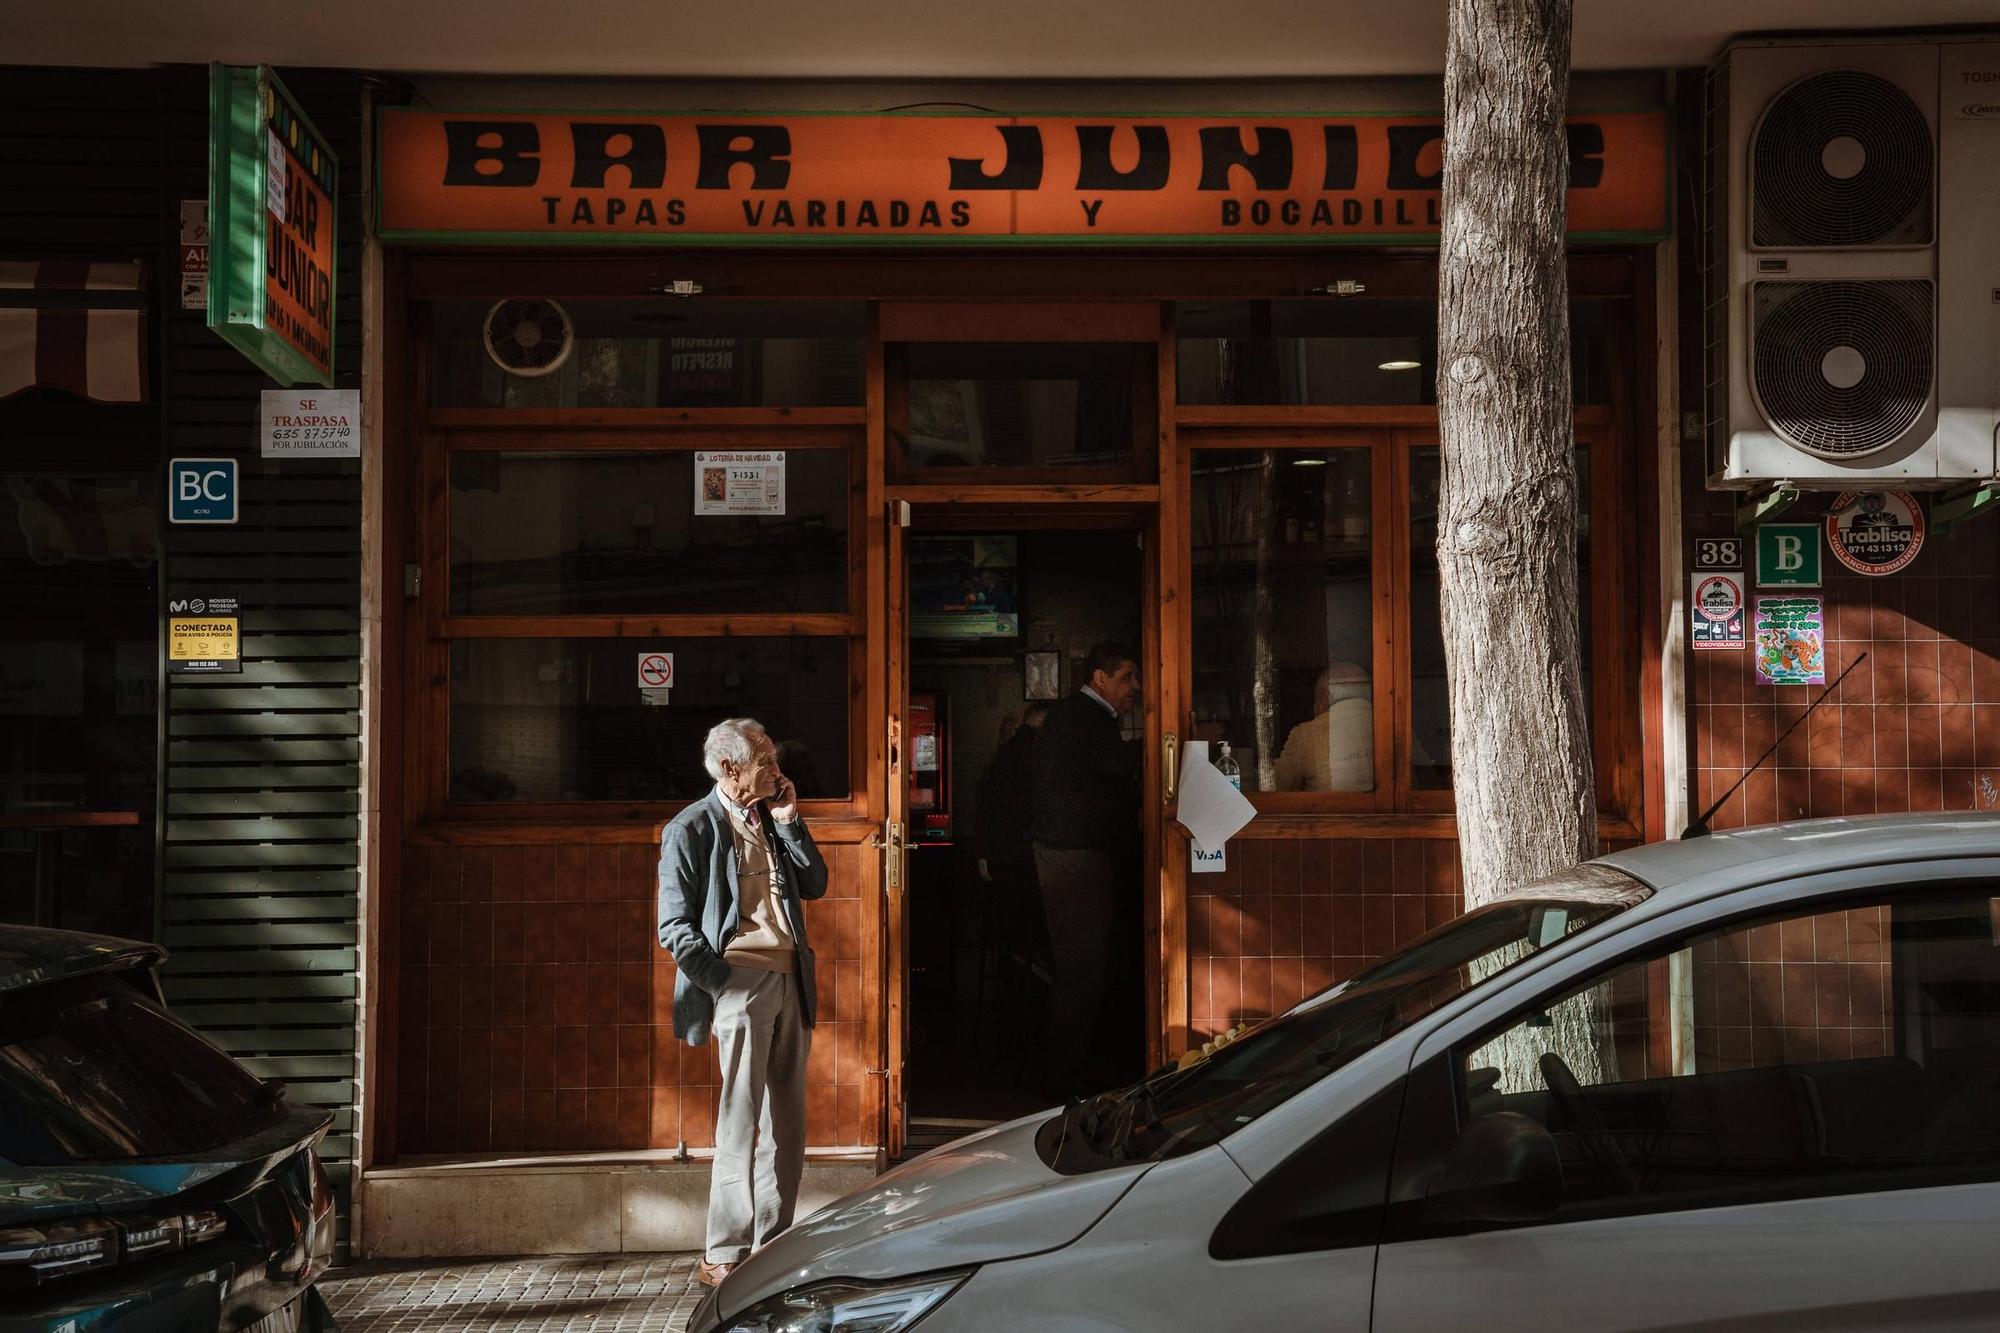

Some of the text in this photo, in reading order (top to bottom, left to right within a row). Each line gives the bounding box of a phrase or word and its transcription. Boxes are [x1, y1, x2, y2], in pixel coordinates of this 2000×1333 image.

[443, 121, 791, 190] BAR
[285, 163, 317, 253] BAR
[542, 197, 1442, 228] TAPAS VARIADAS Y BOCADILL
[186, 248, 209, 261] Al
[267, 218, 329, 330] JUNIOR
[300, 400, 317, 411] SE
[272, 416, 349, 427] TRASPASA
[273, 429, 300, 440] 635
[273, 439, 349, 449] POR JUBILACIÓN
[745, 454, 771, 462] NAVIDAD
[179, 470, 227, 501] BC
[1839, 527, 1912, 544] Trablisa
[1702, 541, 1737, 564] 38
[1774, 535, 1803, 570] B
[1831, 531, 1921, 573] VIGILANCIA PERMANENTE
[1848, 545, 1865, 554] 971
[1867, 544, 1879, 553] 43
[1894, 543, 1905, 552] 13
[174, 624, 233, 632] CONECTADA
